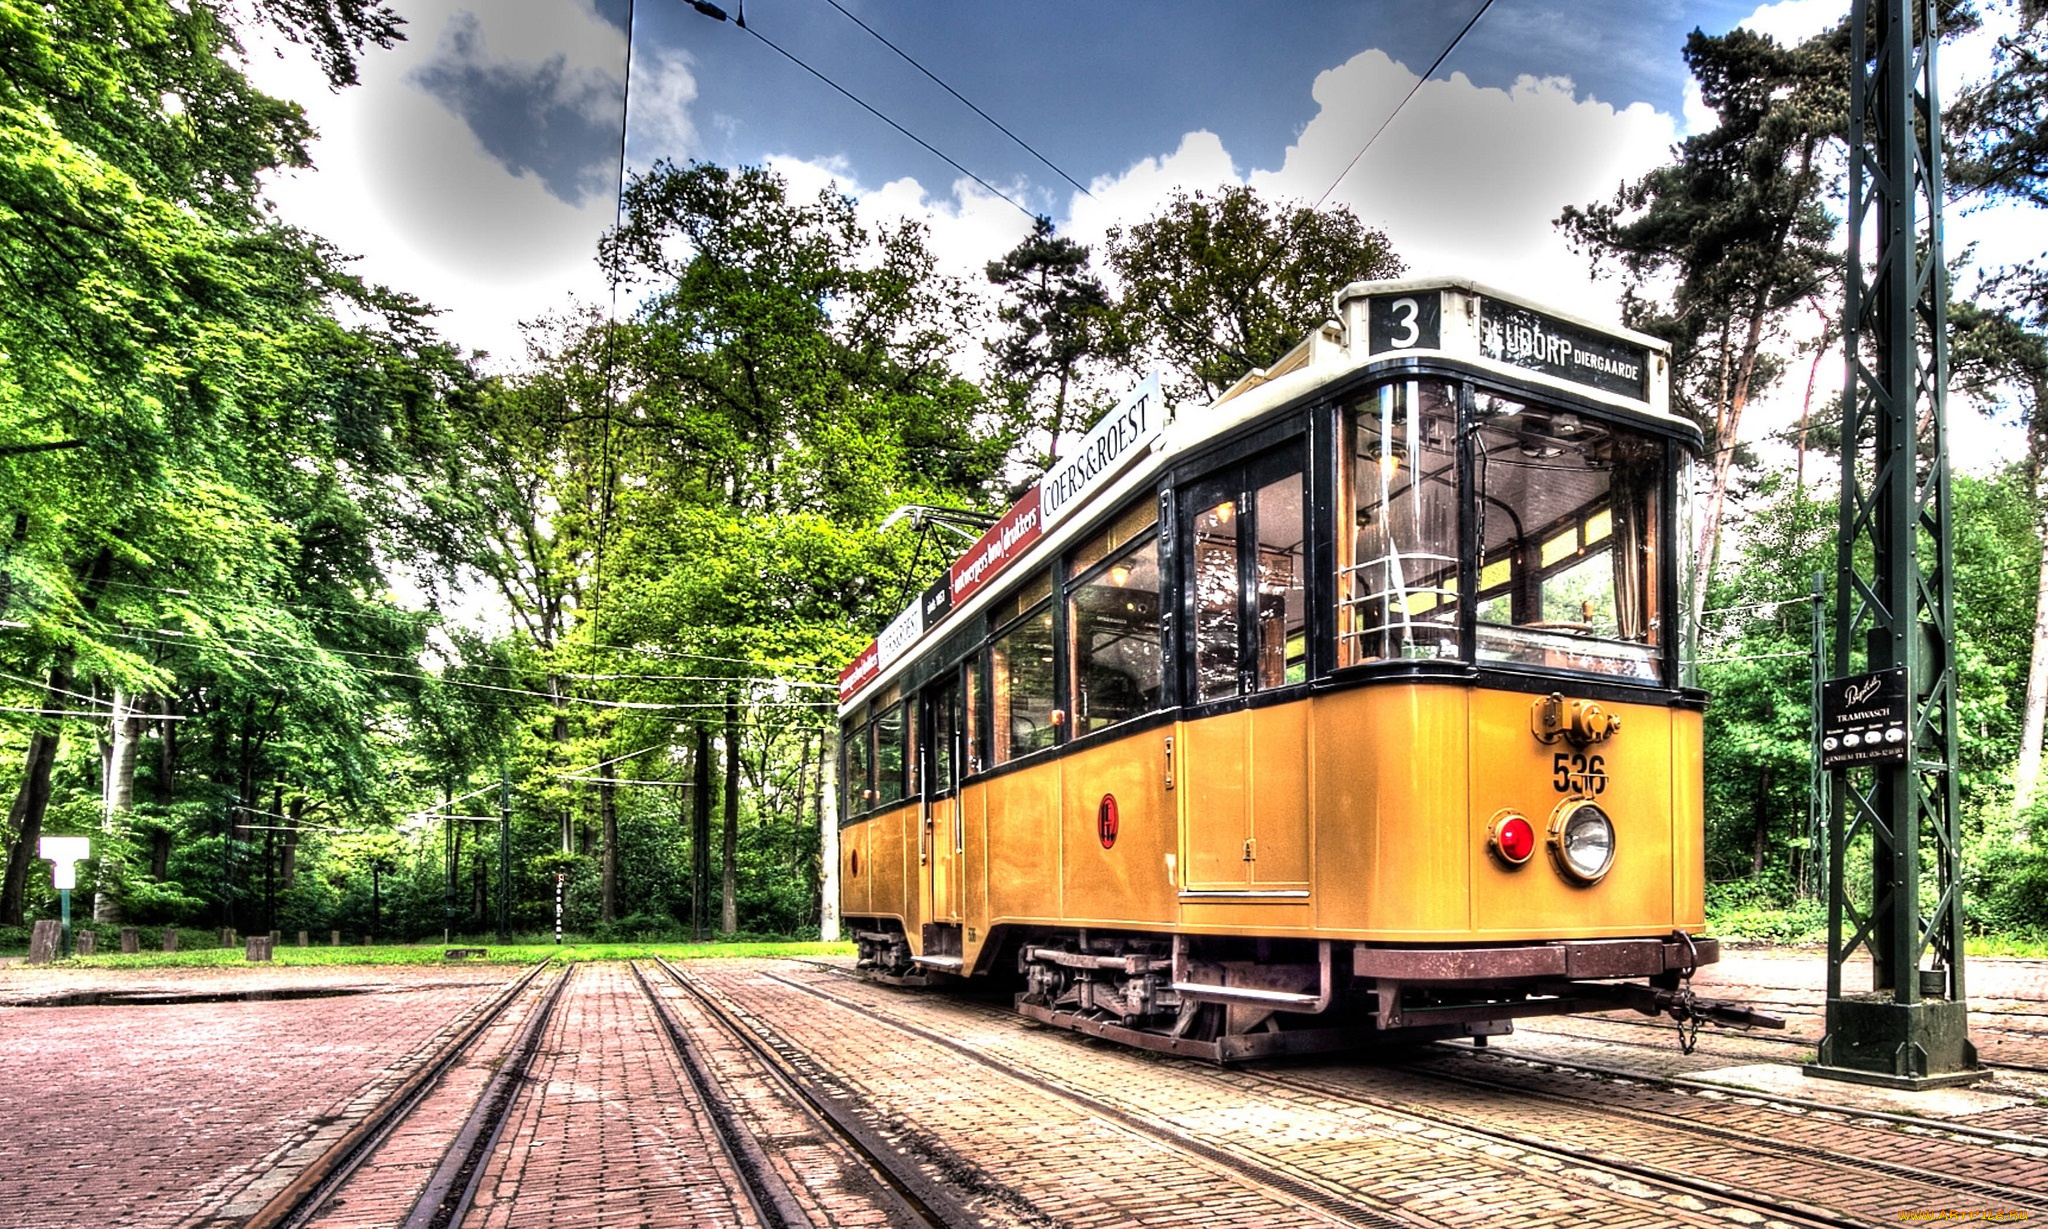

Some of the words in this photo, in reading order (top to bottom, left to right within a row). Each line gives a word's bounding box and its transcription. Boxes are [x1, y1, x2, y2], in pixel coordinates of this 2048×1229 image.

[1390, 297, 1420, 348] 3
[1574, 350, 1639, 380] DIERGAARDE
[1043, 393, 1150, 517] COERS&ROEST
[1837, 708, 1890, 722] TRAMWASCH
[1553, 752, 1606, 794] 536
